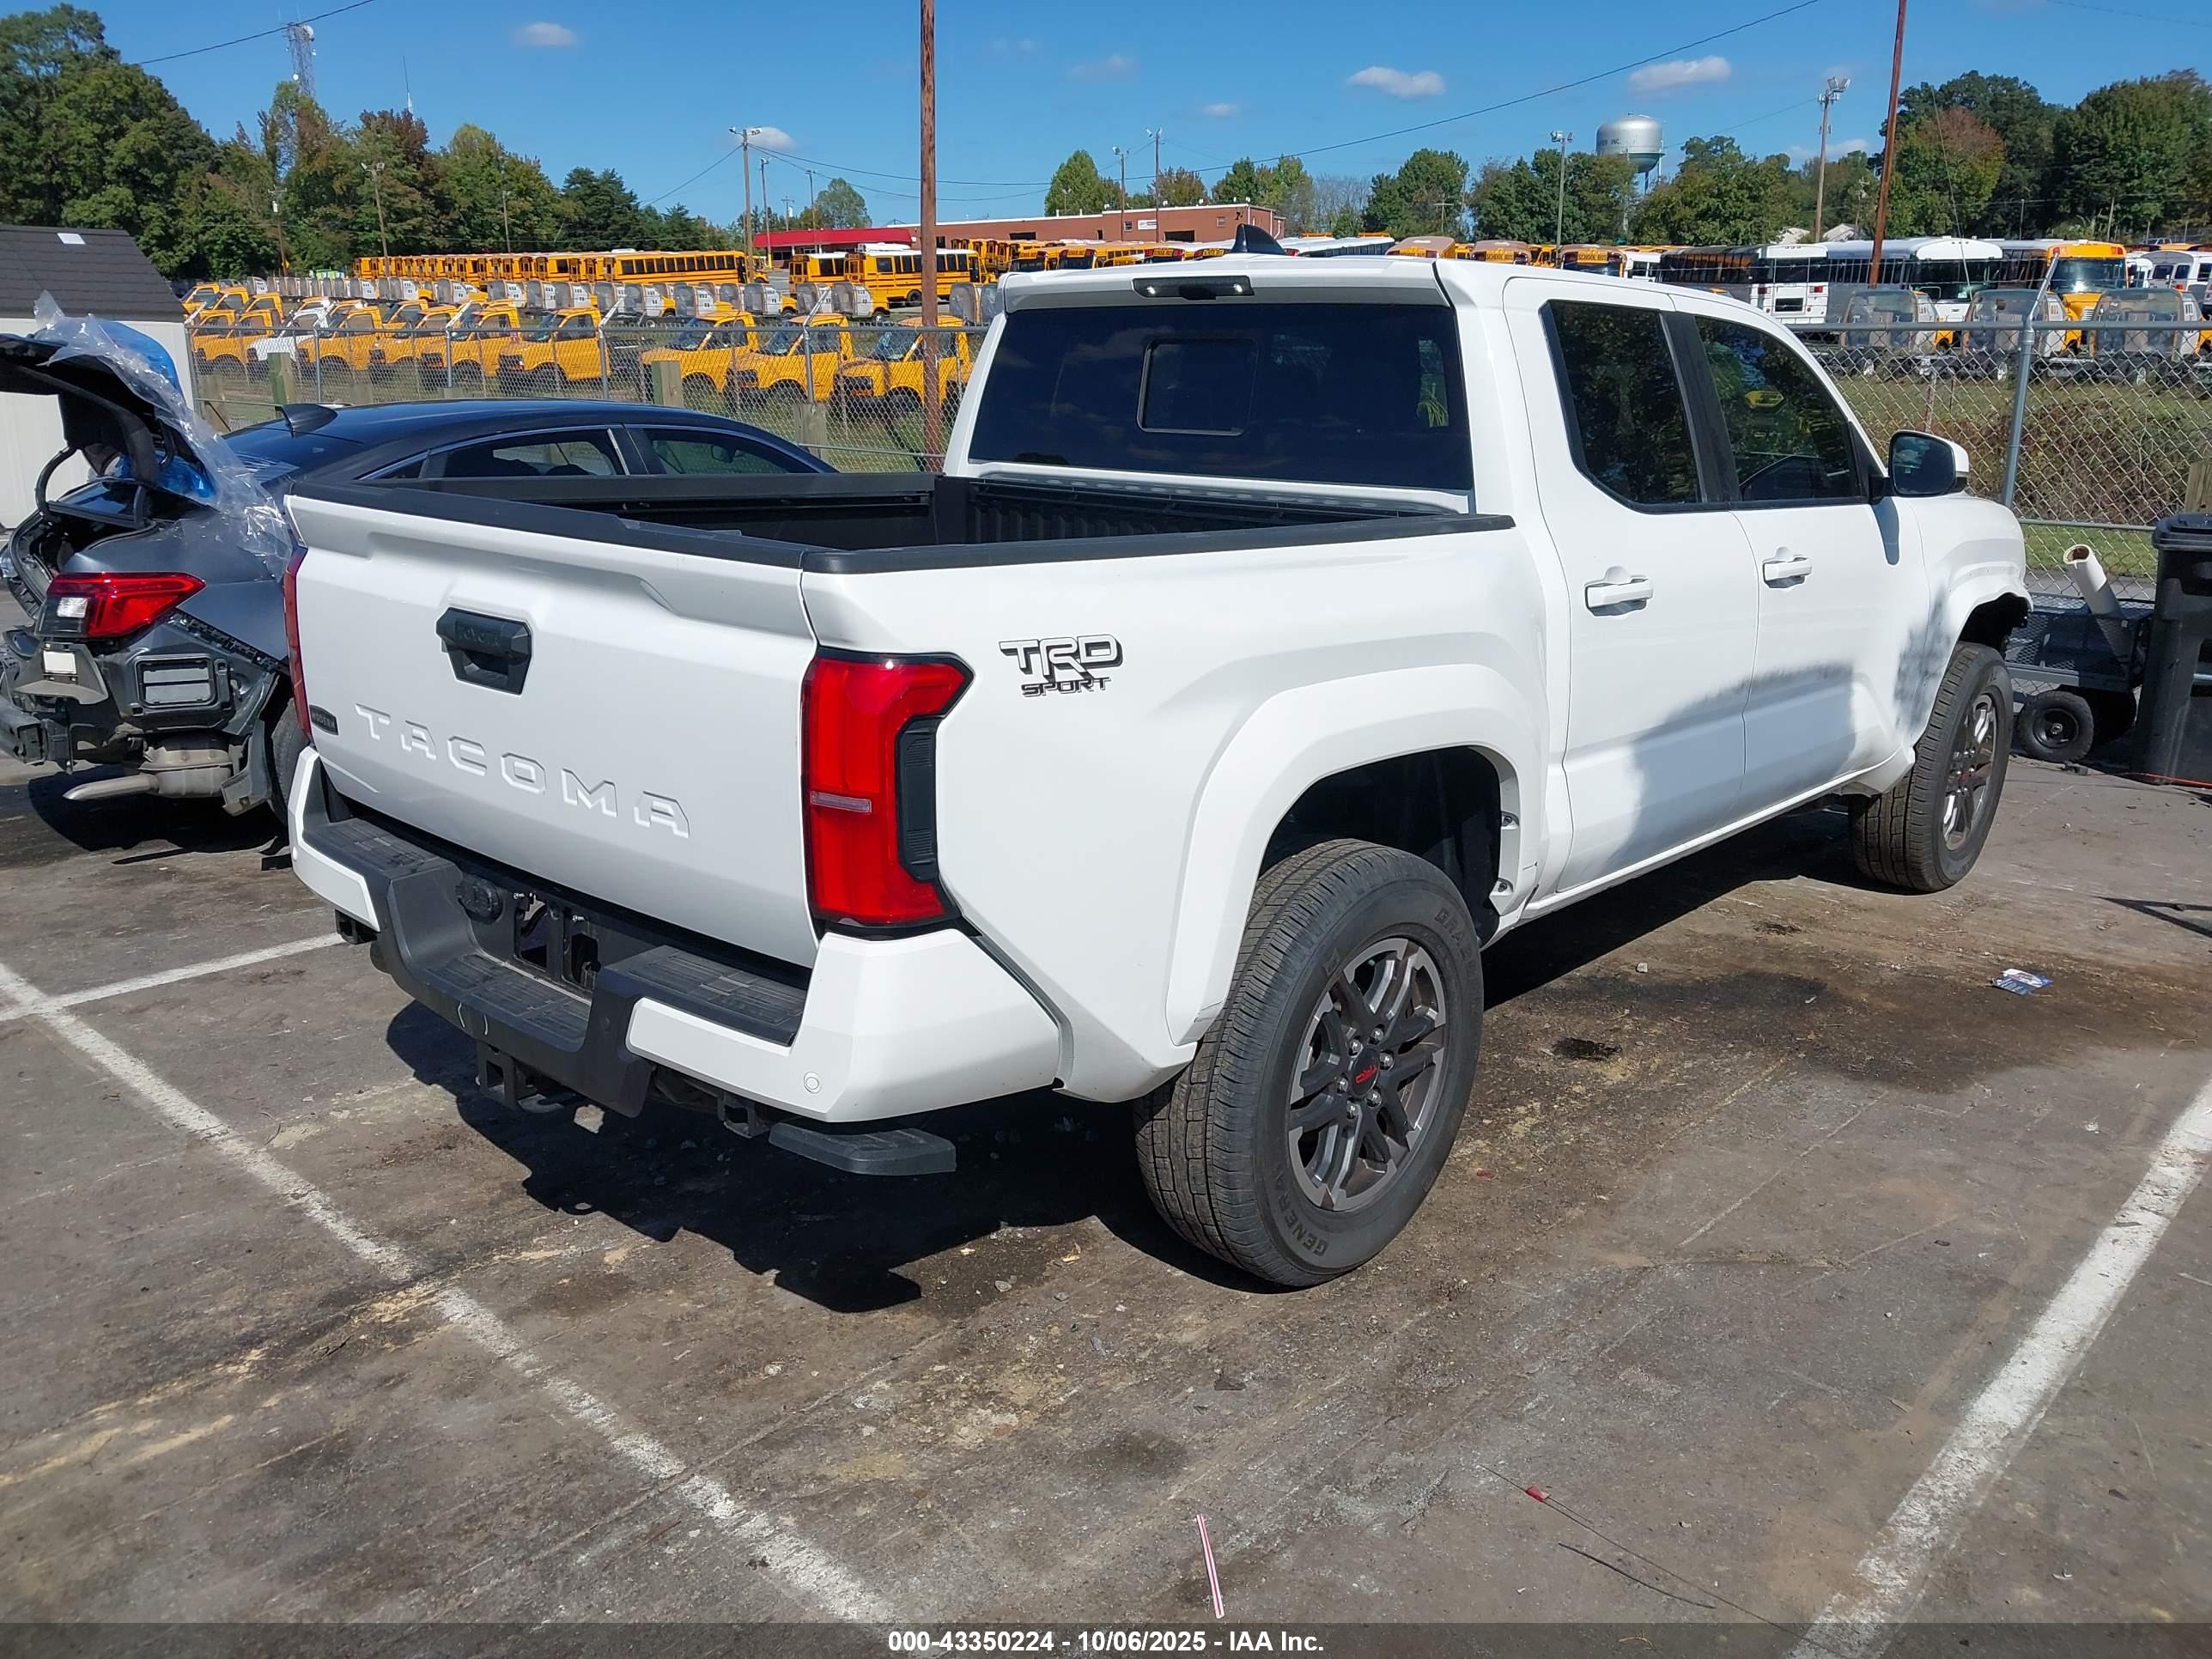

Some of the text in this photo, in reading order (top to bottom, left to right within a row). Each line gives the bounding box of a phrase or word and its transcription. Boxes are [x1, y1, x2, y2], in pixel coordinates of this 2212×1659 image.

[998, 634, 1123, 679] TRD
[1021, 677, 1111, 697] SPORT
[355, 703, 690, 839] TACOMA
